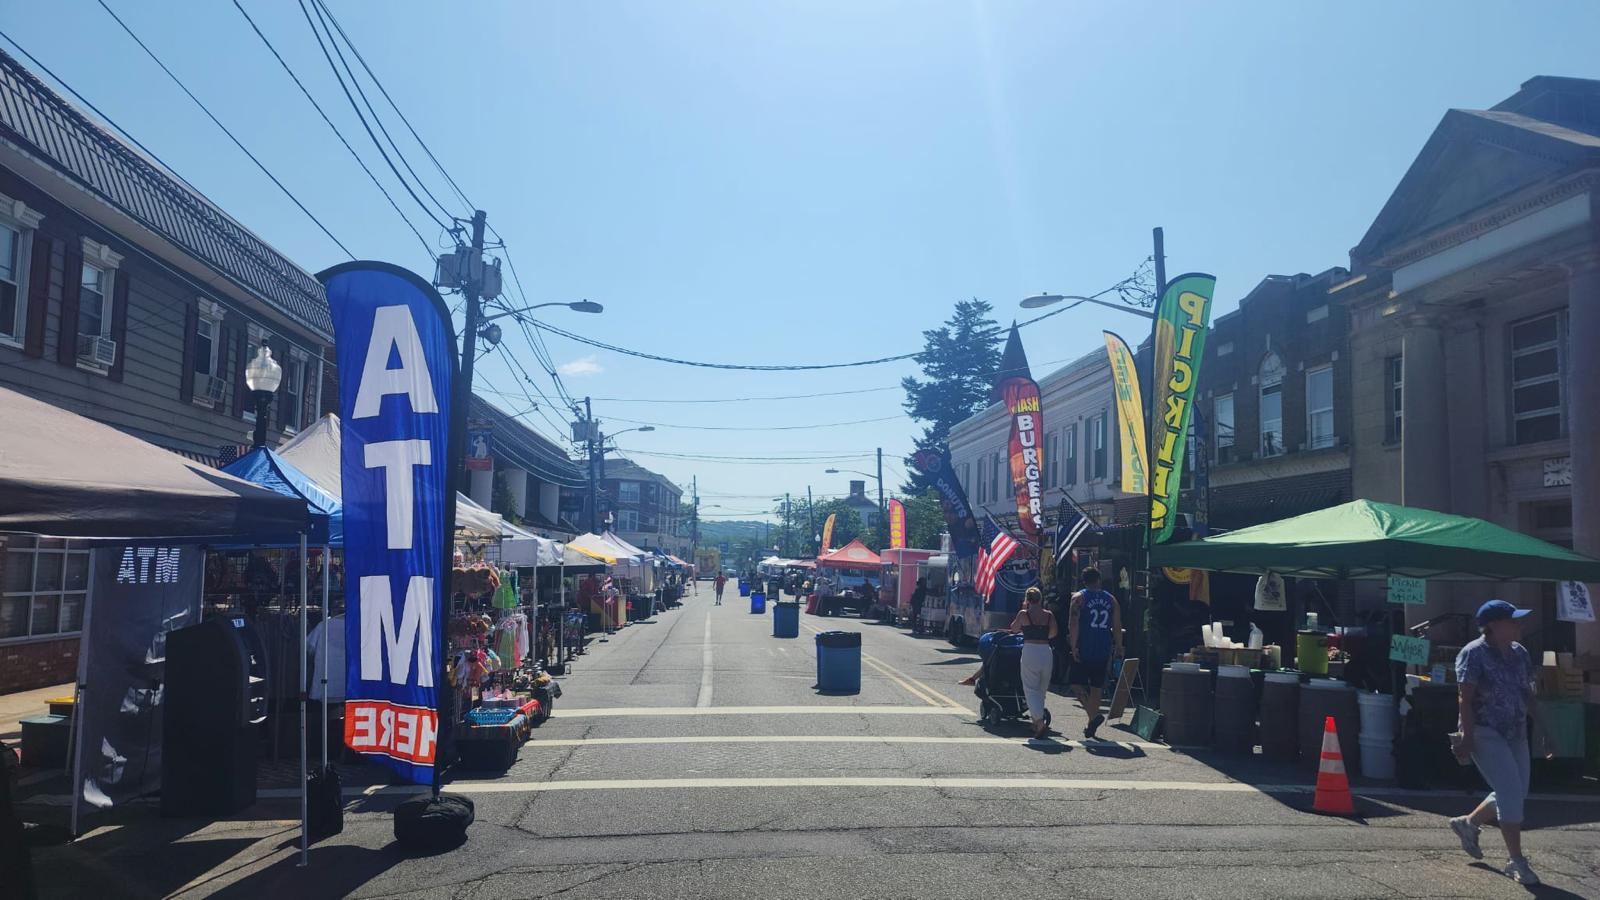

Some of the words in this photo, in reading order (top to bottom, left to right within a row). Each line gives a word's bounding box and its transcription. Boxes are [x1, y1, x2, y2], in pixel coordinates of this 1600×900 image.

[1012, 396, 1040, 415] ASH
[351, 303, 439, 688] ATM
[937, 478, 967, 519] DONUTS
[116, 546, 181, 584] ATM
[1090, 609, 1109, 629] 22
